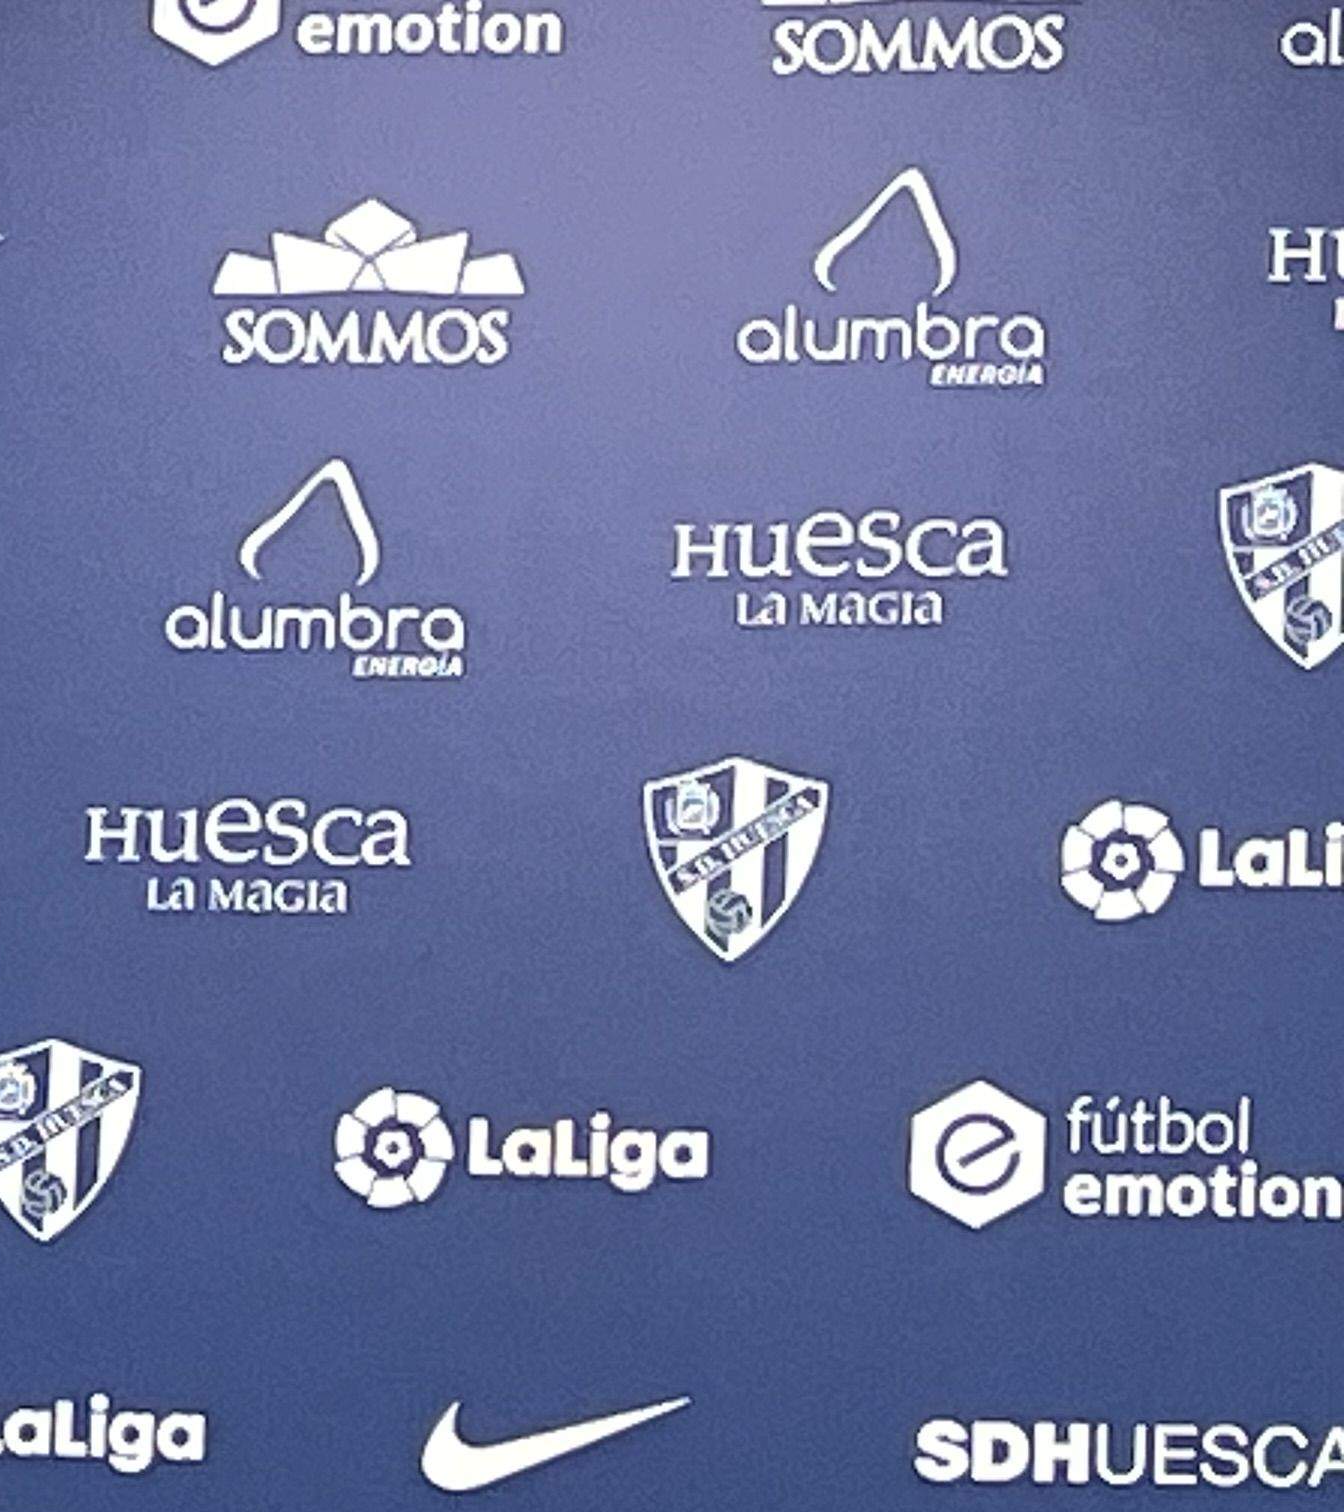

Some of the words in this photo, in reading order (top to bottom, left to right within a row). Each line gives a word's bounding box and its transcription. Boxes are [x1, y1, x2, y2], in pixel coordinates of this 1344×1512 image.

[297, 0, 562, 54] emotion
[772, 14, 1064, 75] SOMMOS
[223, 308, 508, 364] SOMMOS
[737, 301, 1044, 363] alumbra
[165, 590, 465, 654] alumbra
[468, 1112, 708, 1191] LaLiga
[1066, 1095, 1250, 1154] fútbol
[1063, 1159, 1342, 1218] emotion
